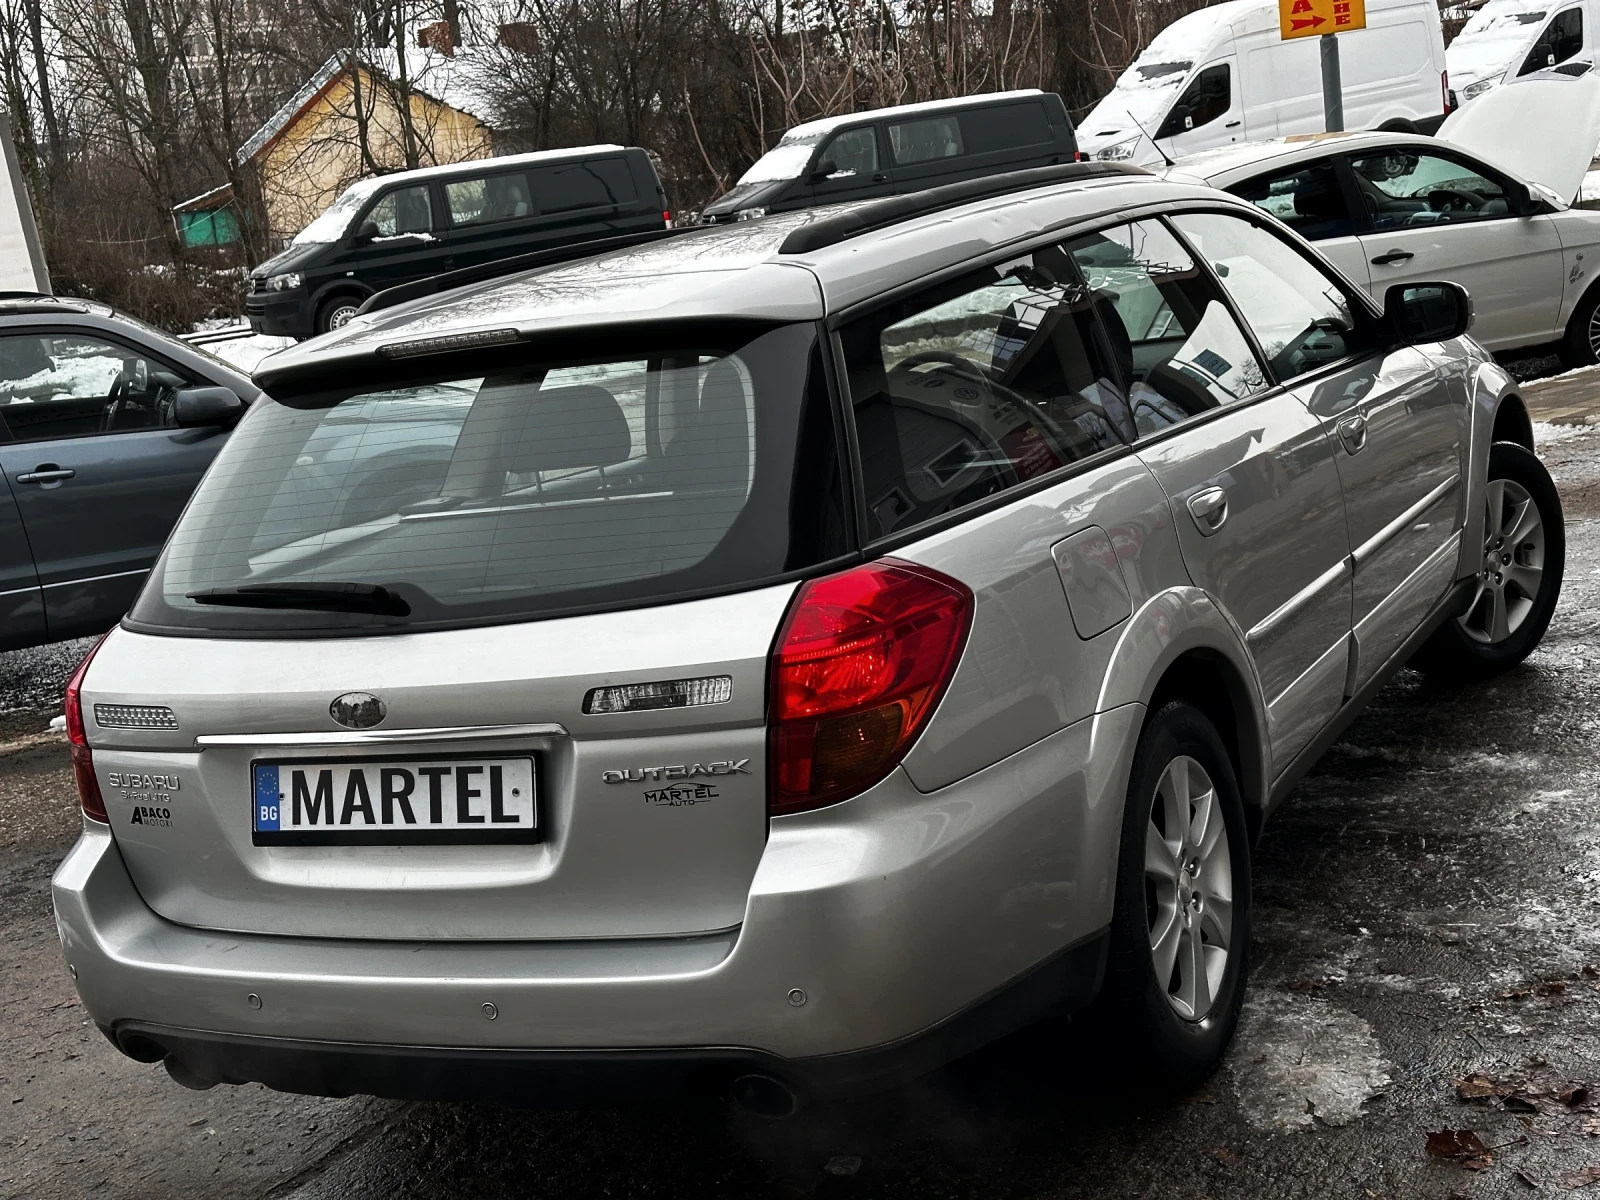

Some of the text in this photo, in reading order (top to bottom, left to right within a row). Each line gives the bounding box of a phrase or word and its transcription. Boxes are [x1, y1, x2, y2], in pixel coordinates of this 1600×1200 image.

[602, 758, 752, 784] OUTBACK
[108, 772, 181, 791] SUBARU
[291, 765, 521, 826] MARTEL
[643, 786, 720, 803] MARTEL
[669, 799, 697, 807] AUTO
[130, 806, 171, 825] ABACO
[260, 805, 278, 821] BG
